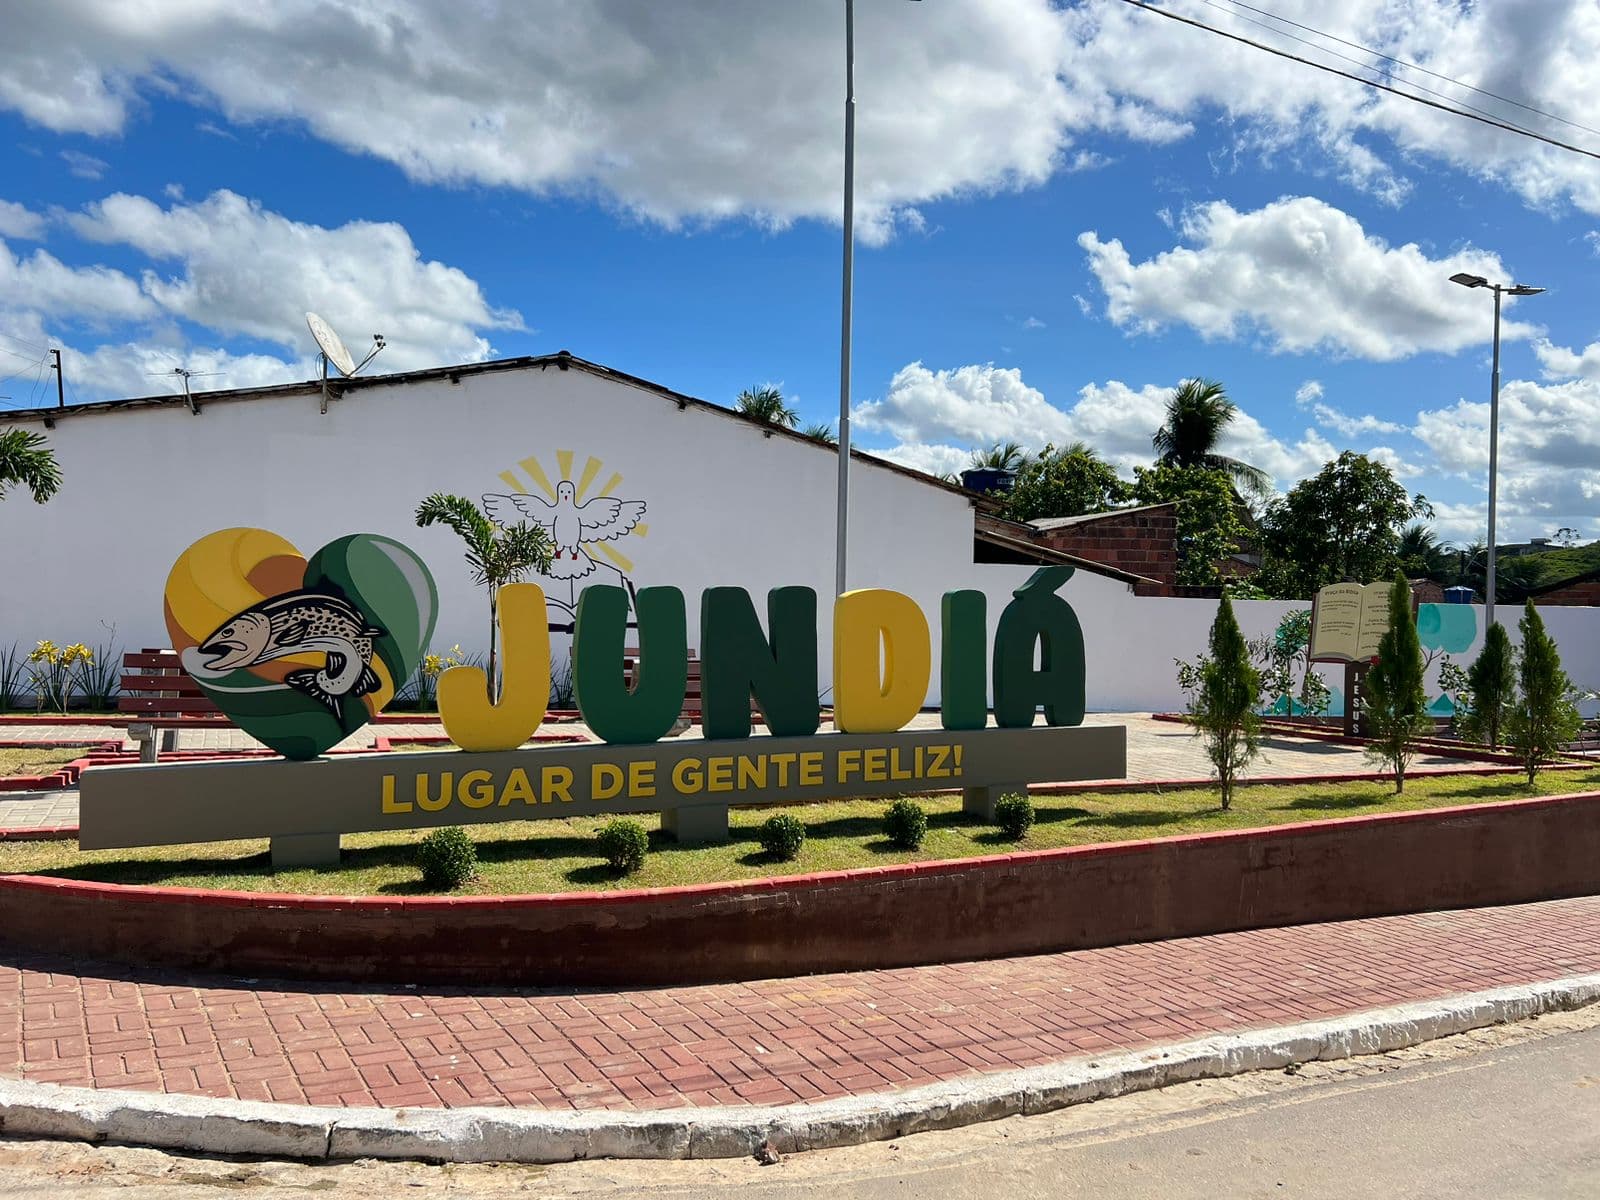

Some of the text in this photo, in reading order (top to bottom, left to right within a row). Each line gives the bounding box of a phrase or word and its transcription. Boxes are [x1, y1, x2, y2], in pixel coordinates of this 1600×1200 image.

[437, 565, 1086, 752] JUNDIÁ
[1352, 672, 1360, 734] JESUS
[381, 744, 963, 814] LUGAR DE GENTE FELIZ!
